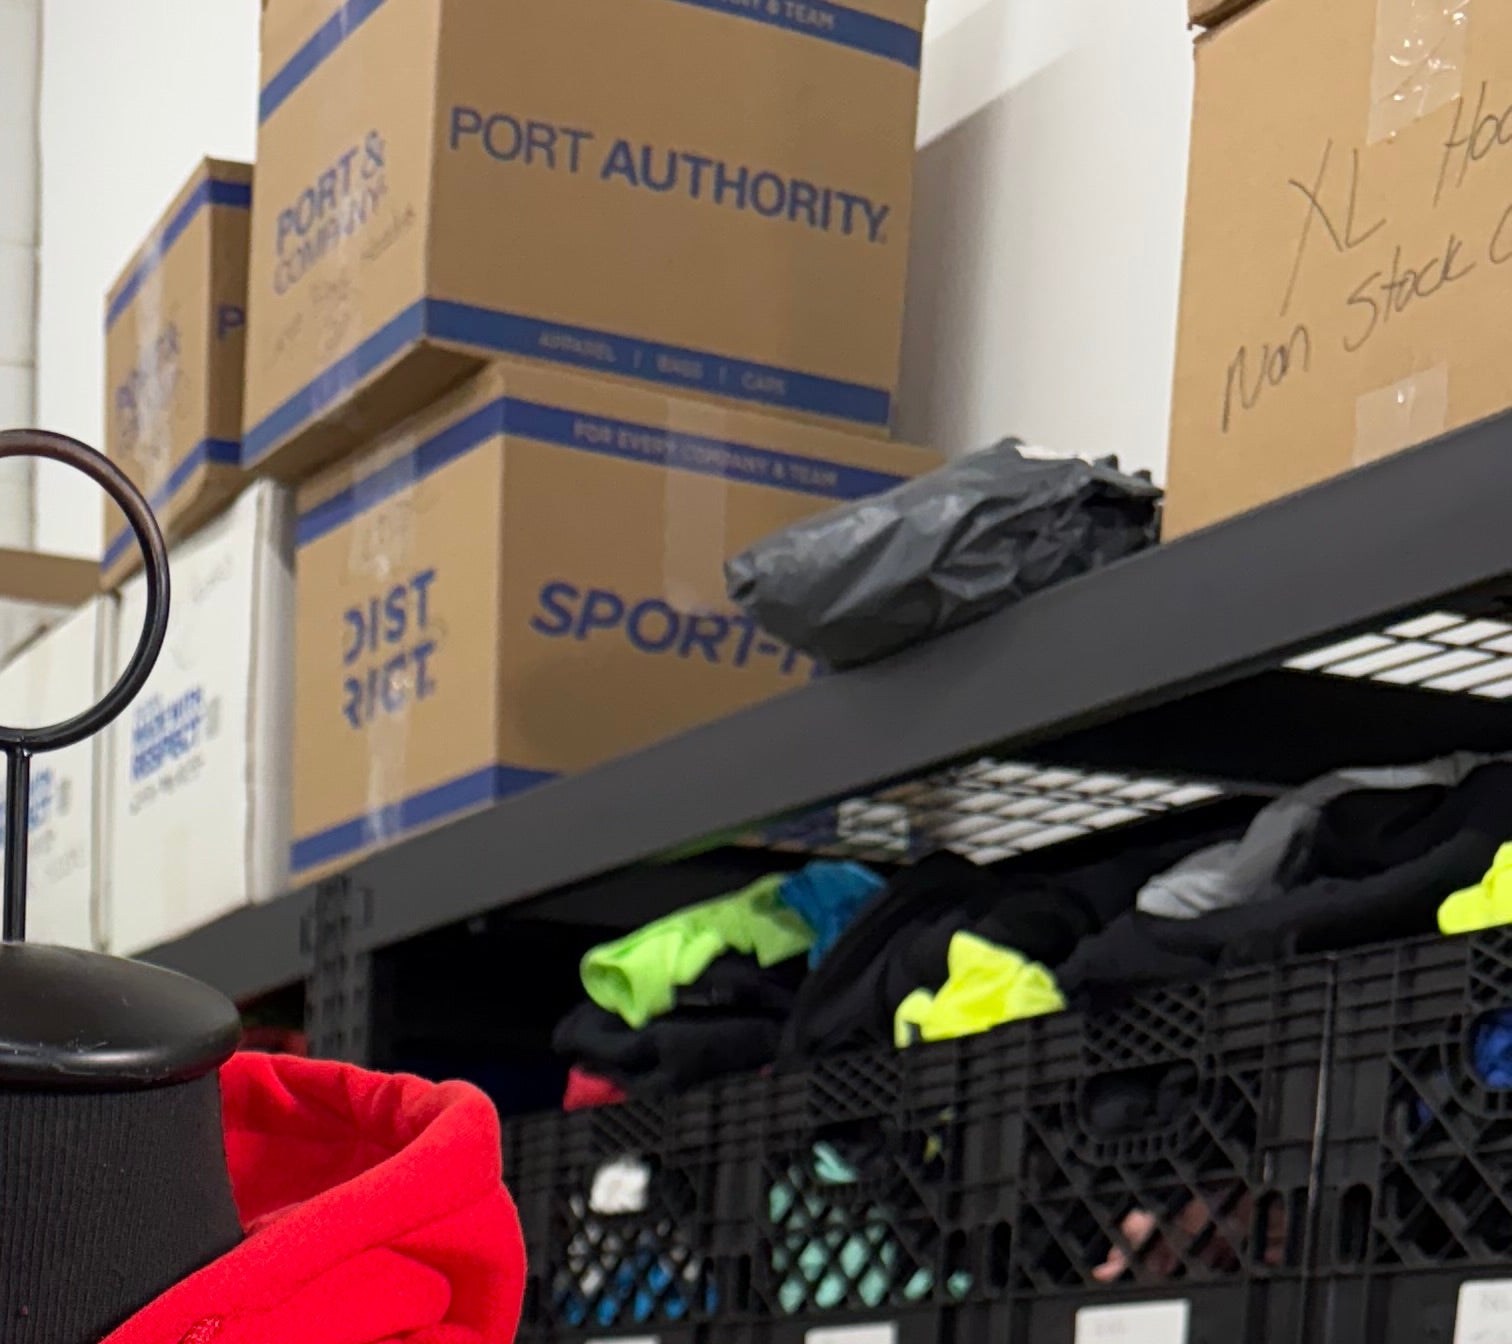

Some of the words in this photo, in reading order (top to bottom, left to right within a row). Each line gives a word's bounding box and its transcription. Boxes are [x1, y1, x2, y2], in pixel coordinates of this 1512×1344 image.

[785, 2, 835, 31] TEAM
[276, 146, 359, 257] PORT
[361, 130, 386, 180] &
[449, 105, 594, 174] PORT
[600, 138, 890, 243] AUTHORITY
[1281, 137, 1387, 317] XL
[1222, 322, 1311, 434] Non
[1343, 232, 1477, 354] Stock
[572, 418, 613, 446] FOR
[530, 580, 825, 678] SPORT-
